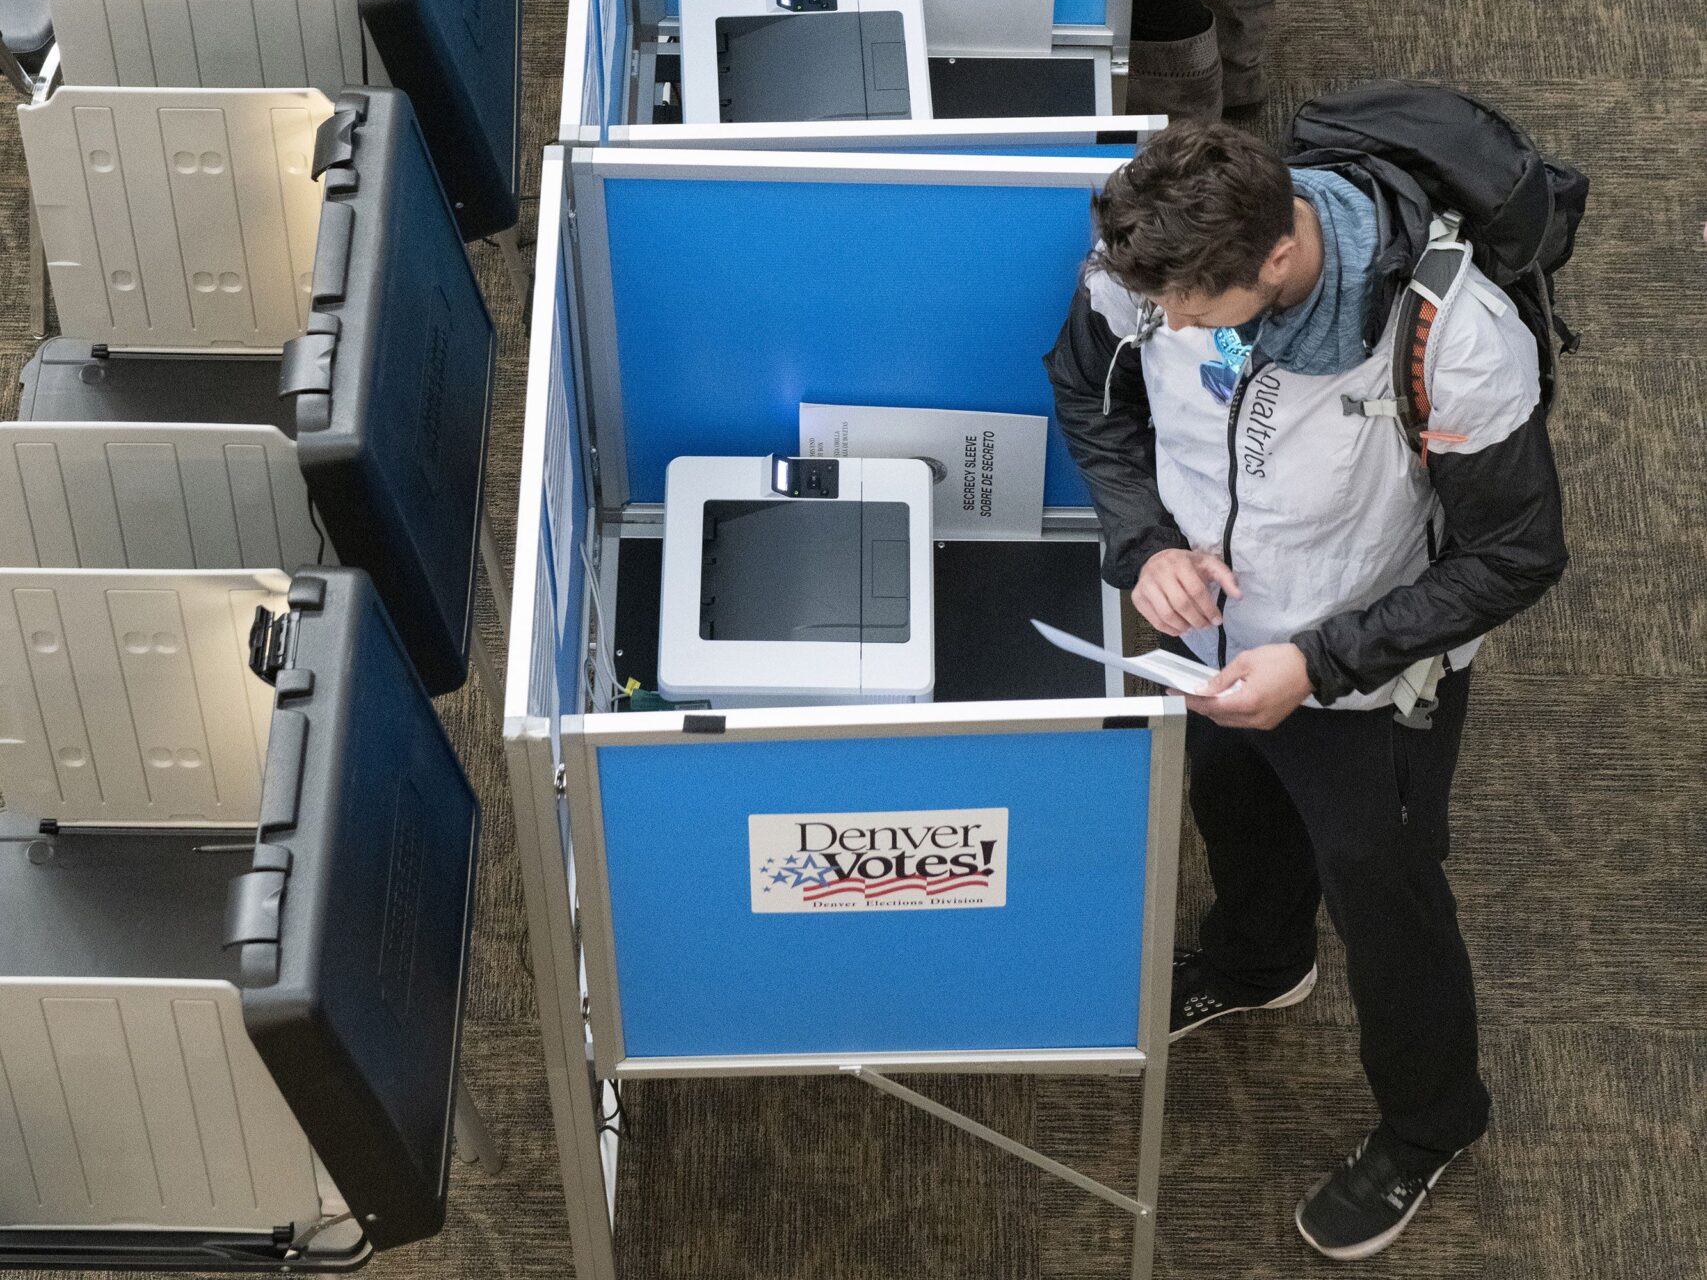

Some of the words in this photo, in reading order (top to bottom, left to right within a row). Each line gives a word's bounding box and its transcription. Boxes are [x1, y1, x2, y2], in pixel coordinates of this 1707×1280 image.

[1244, 374, 1281, 479] qualtrics
[964, 435, 977, 469] SLEEVE
[982, 430, 995, 471] SECRETO
[963, 470, 976, 511] SECRECY
[981, 473, 993, 486] DE
[980, 487, 992, 518] SOBRE
[795, 822, 982, 852] Denver
[819, 839, 997, 881] Votes!
[813, 900, 857, 908] Denver
[866, 899, 924, 907] Elections
[930, 897, 984, 905] Division
